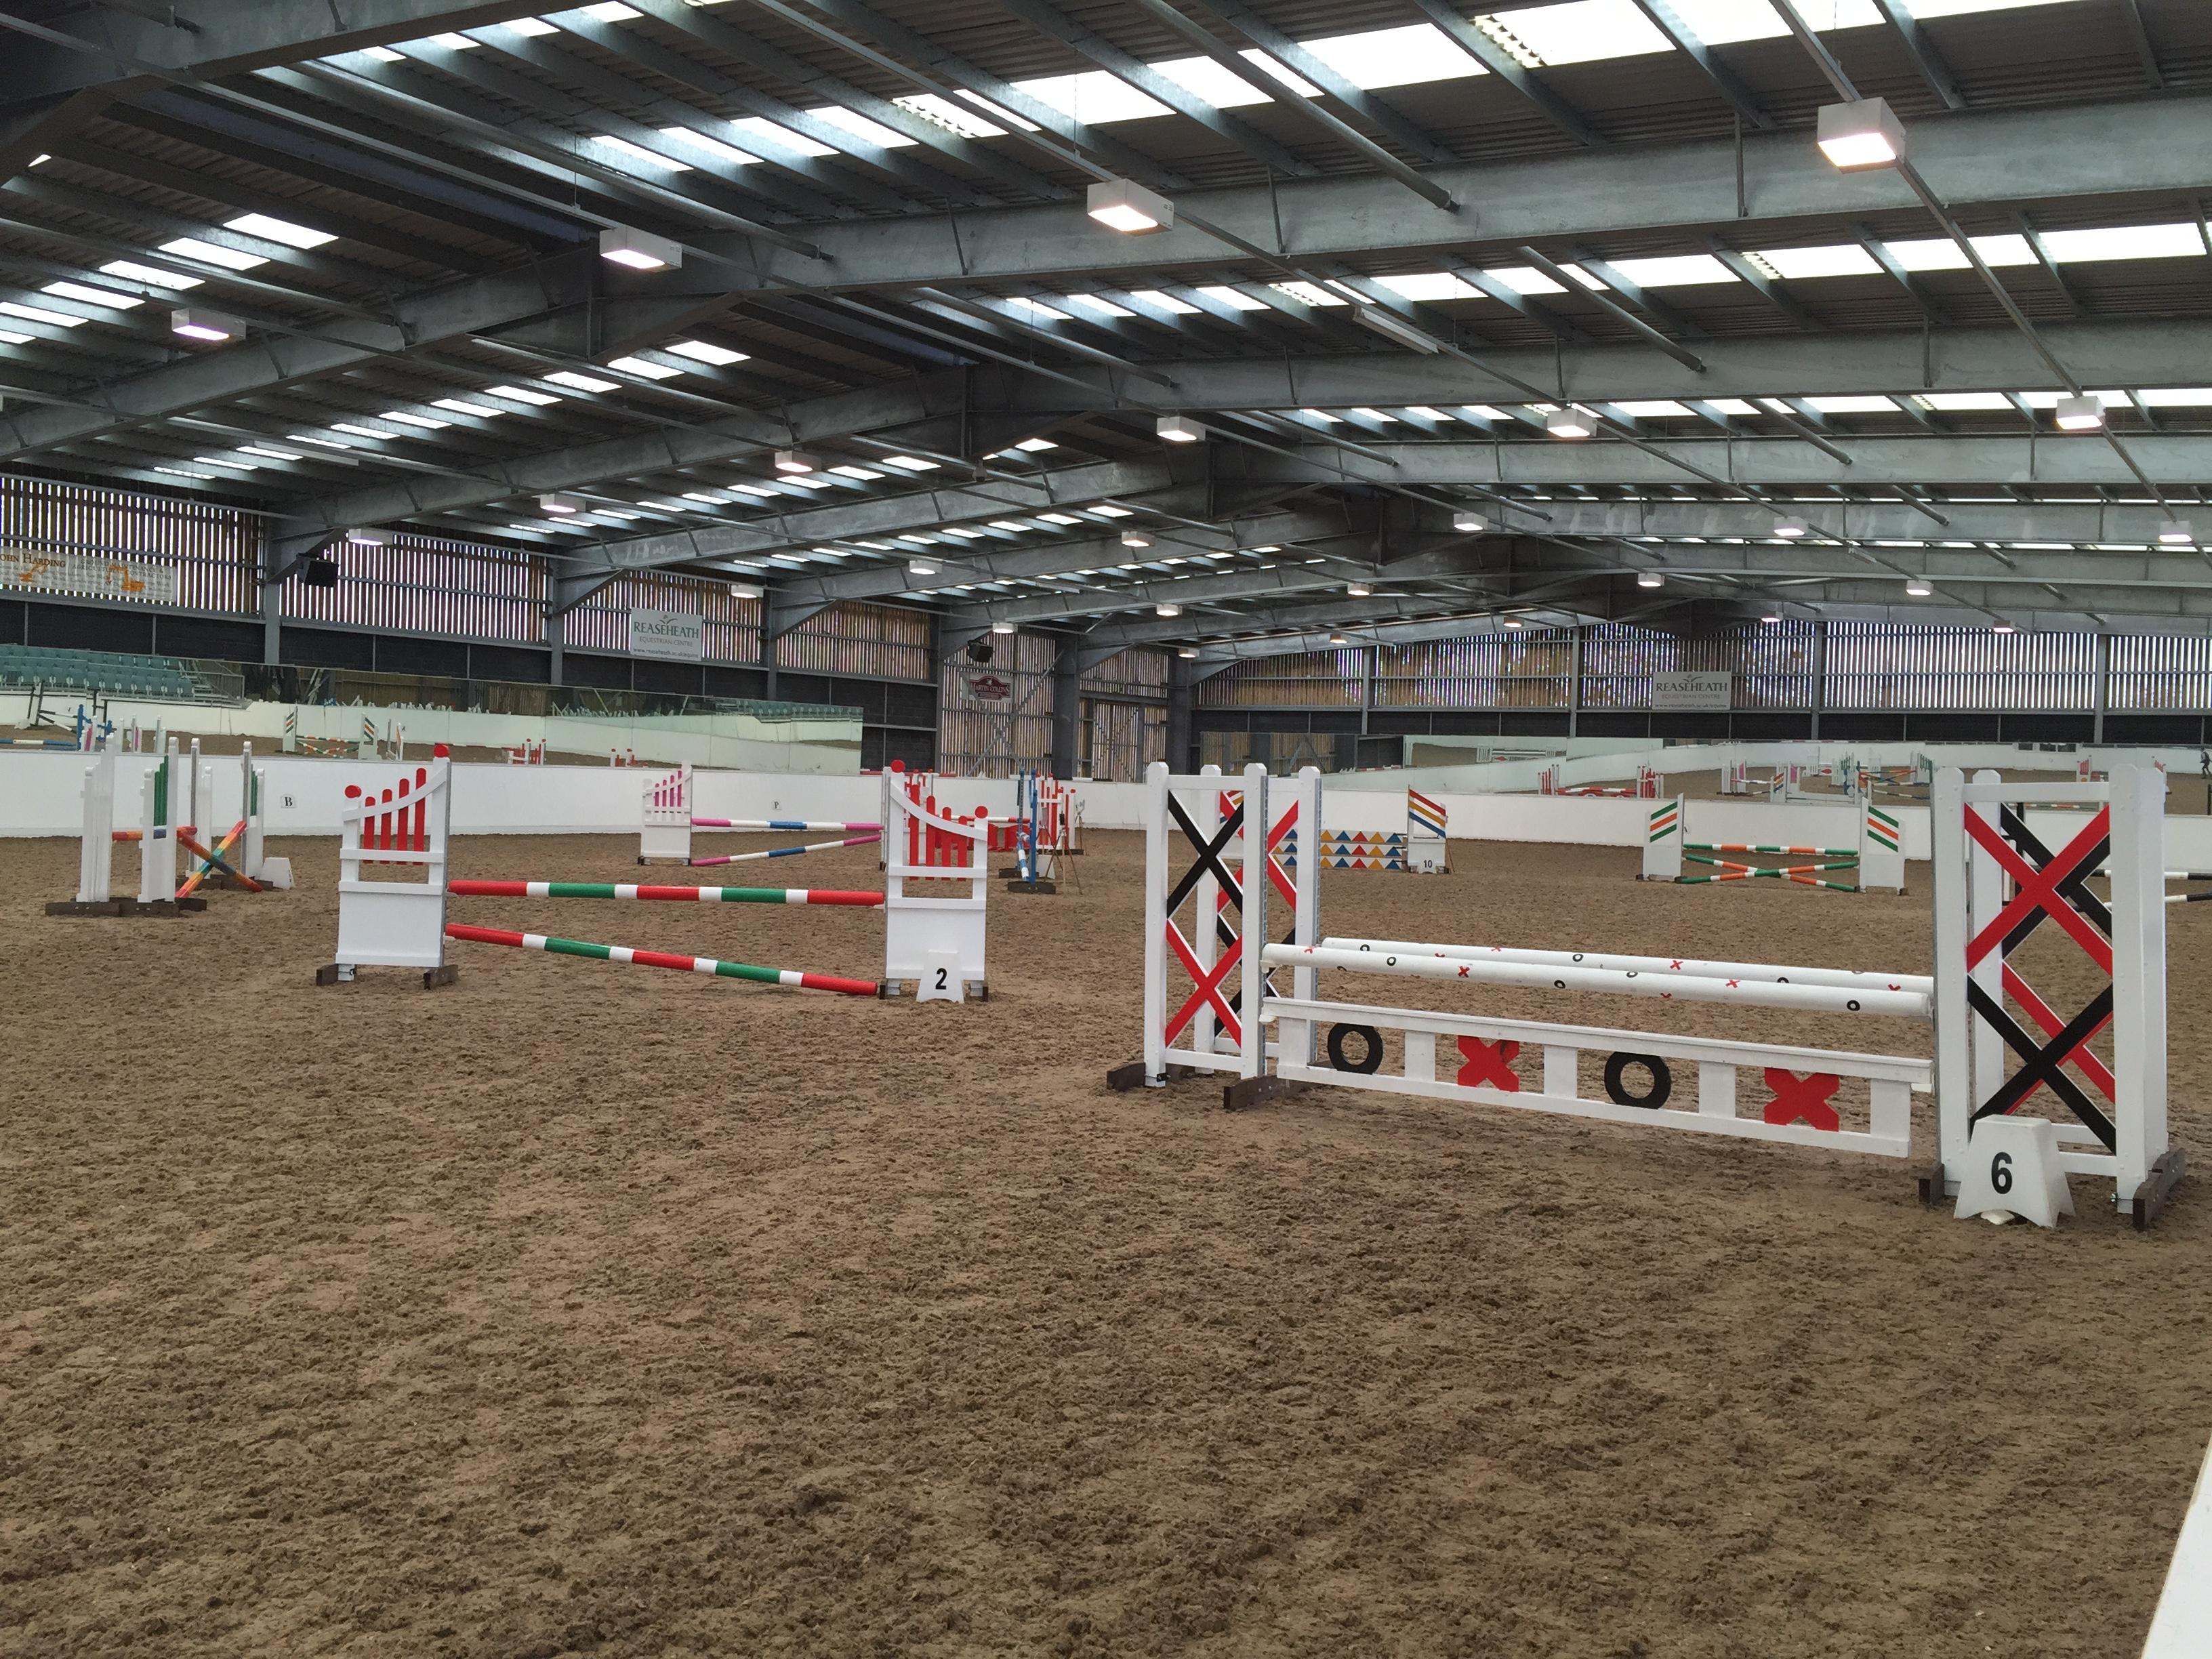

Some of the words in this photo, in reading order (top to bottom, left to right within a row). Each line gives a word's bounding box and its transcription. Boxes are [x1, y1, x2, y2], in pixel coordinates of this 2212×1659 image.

[0, 554, 20, 563] OHN
[634, 621, 699, 639] REASEHEATH
[639, 636, 672, 644] EQUESTRIAN
[1656, 682, 1728, 692] REASEHEATH
[284, 796, 293, 806] B
[1424, 859, 1433, 868] 10
[935, 968, 947, 990] 2
[1991, 1151, 2013, 1195] 6
